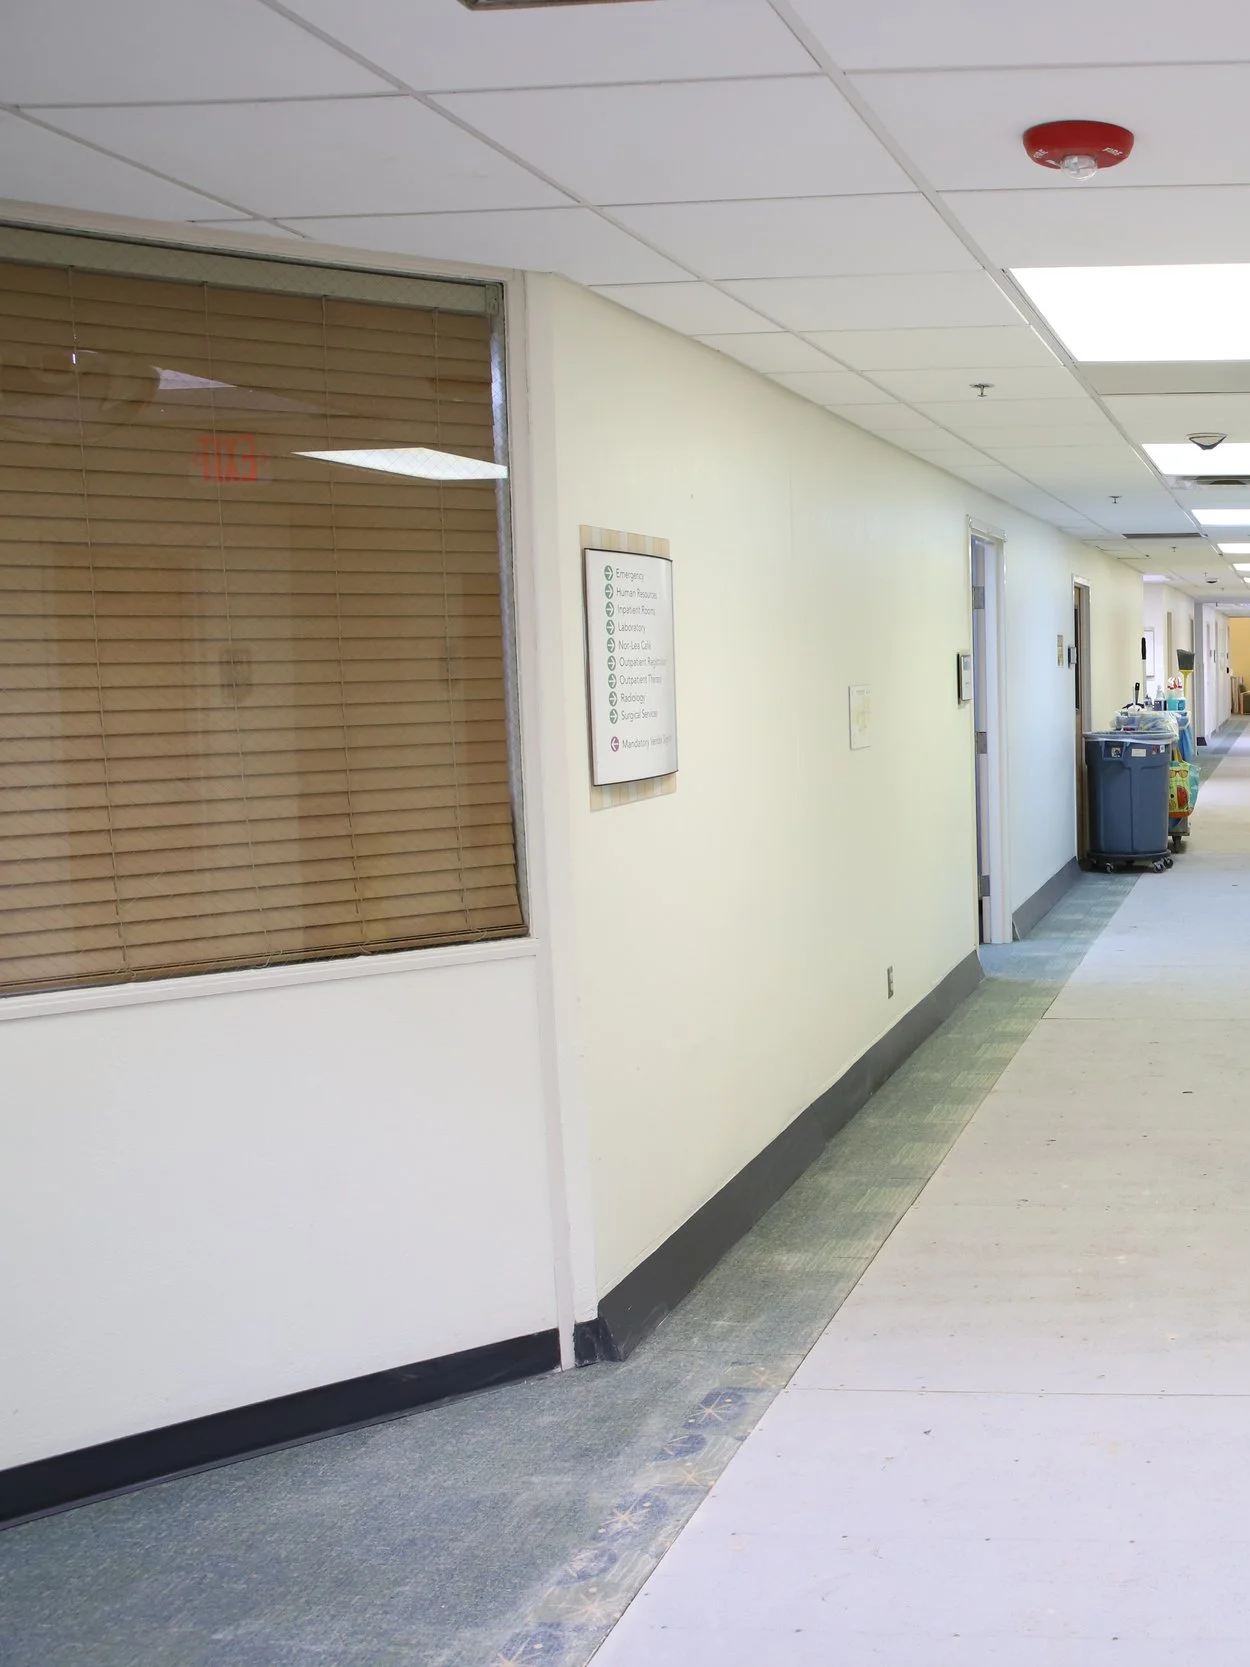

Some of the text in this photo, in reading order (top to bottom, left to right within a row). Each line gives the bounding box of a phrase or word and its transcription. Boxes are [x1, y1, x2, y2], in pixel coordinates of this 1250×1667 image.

[616, 568, 644, 582] Emergency
[617, 587, 636, 598] Human
[617, 604, 640, 616] Inpatient
[618, 621, 645, 634] Laboratory
[619, 640, 640, 650] Nor-Lea
[619, 656, 646, 668] Outpatient
[620, 674, 647, 686] Outpatient
[621, 693, 645, 705] Radiology
[621, 709, 641, 722] Surgical
[622, 738, 649, 750] Mandatory
